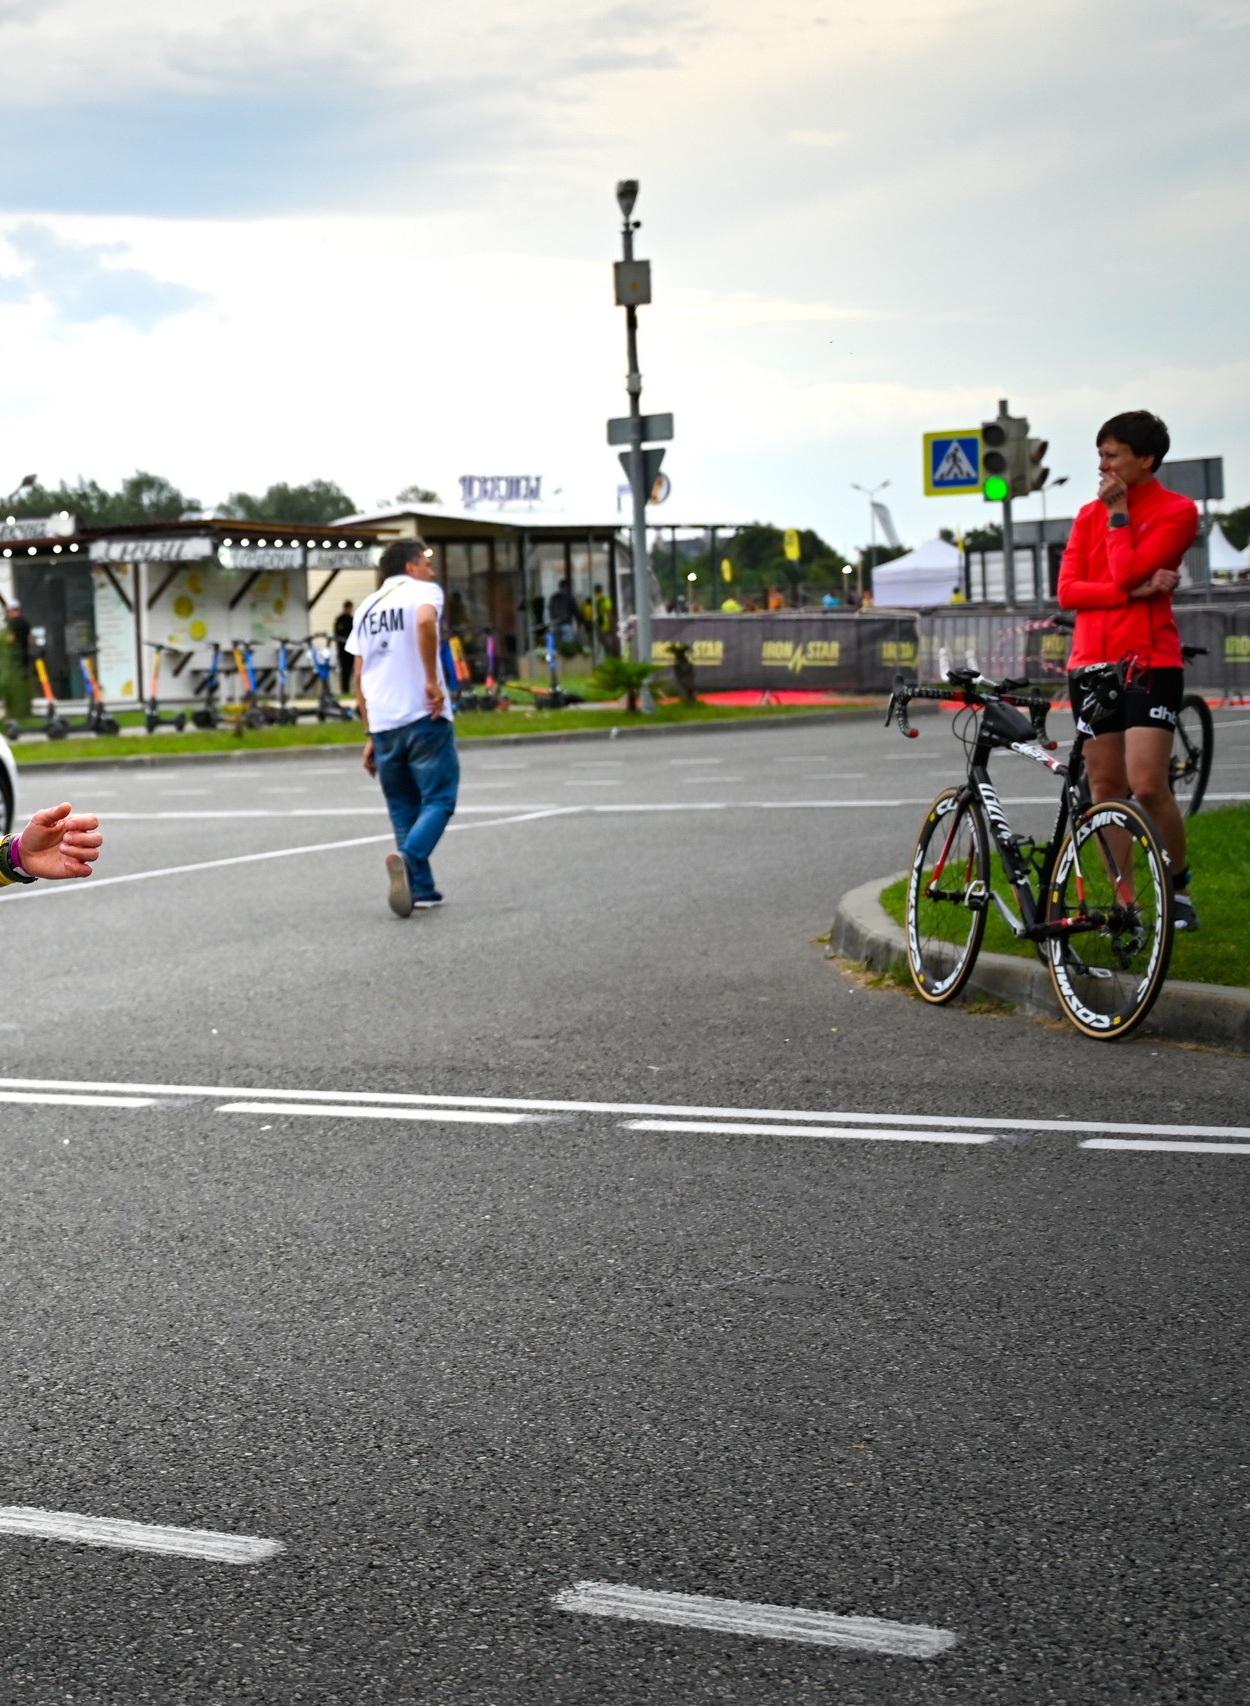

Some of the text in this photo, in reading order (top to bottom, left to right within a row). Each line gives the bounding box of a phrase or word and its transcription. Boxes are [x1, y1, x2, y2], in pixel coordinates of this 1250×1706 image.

[361, 608, 405, 637] TEAM
[693, 641, 725, 658] STAR
[762, 641, 841, 659] IRON STAR
[1051, 938, 1112, 1029] COSMIC
